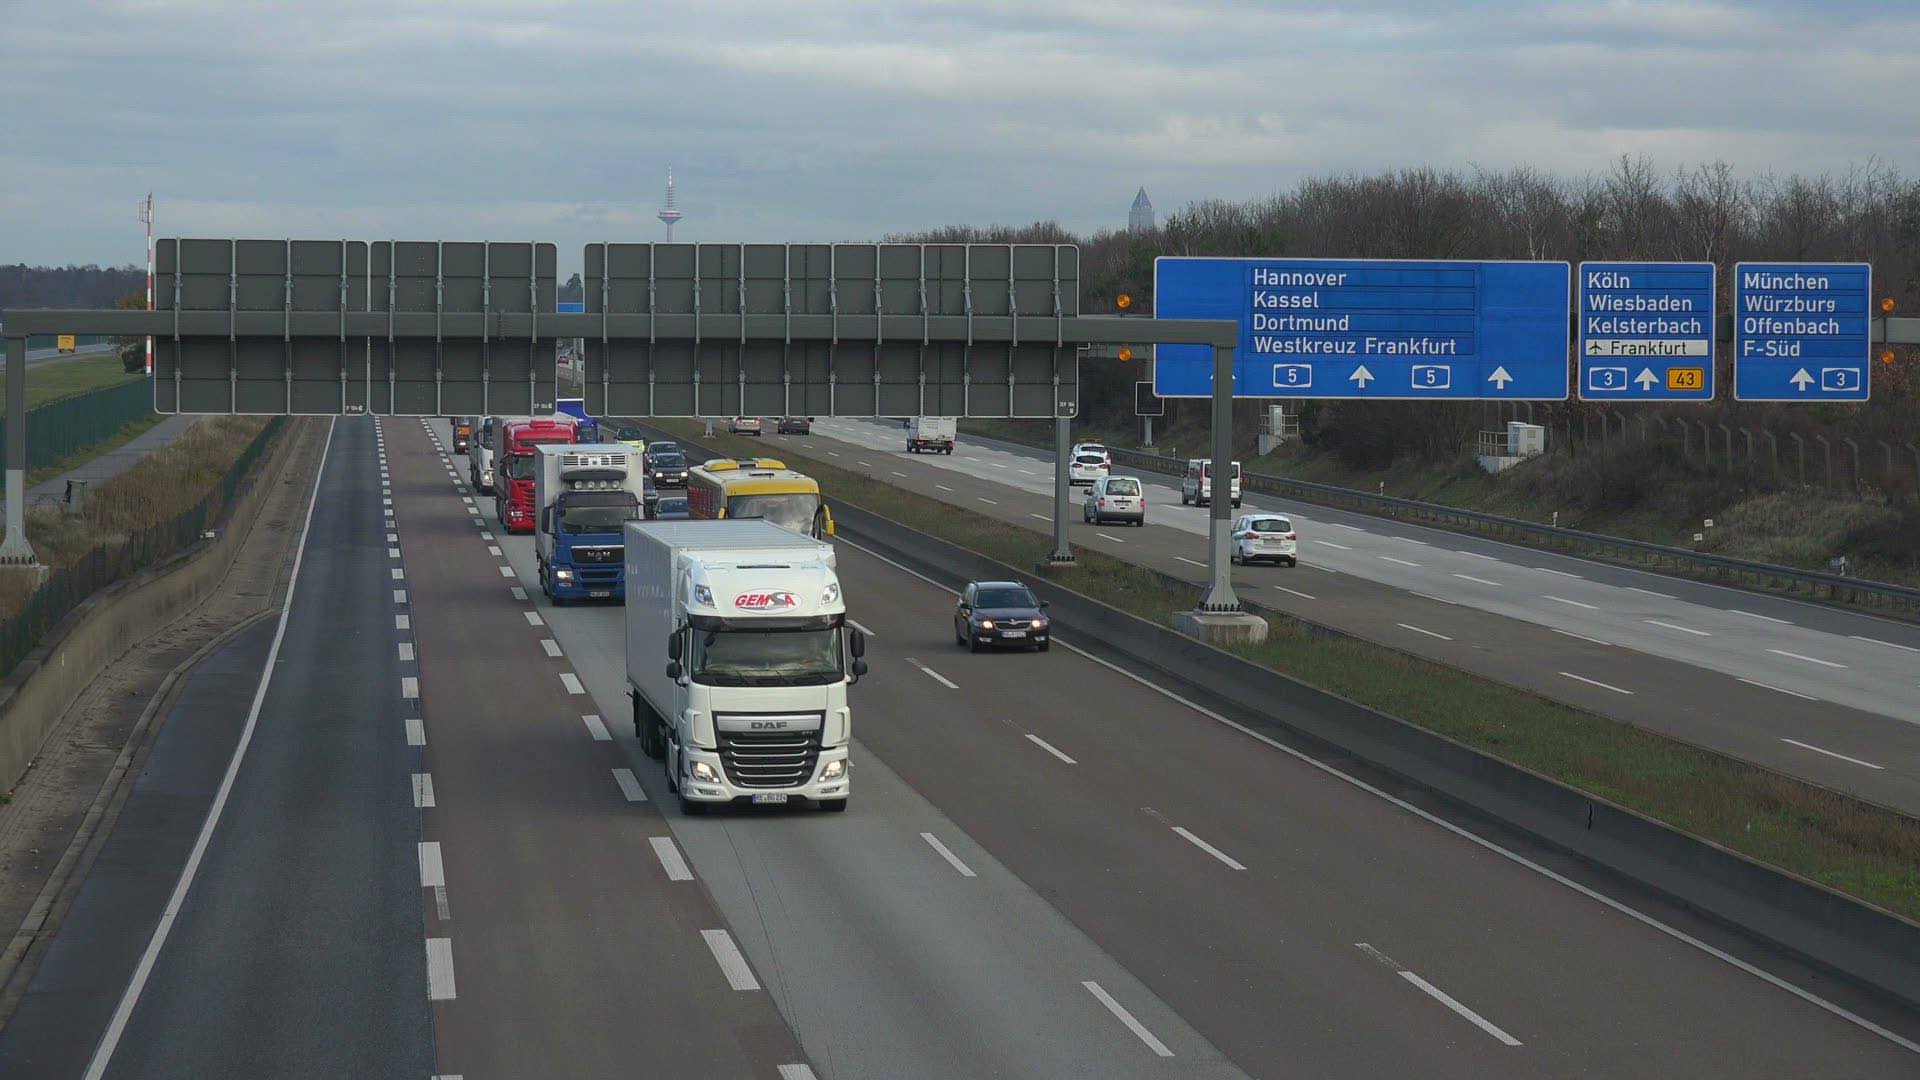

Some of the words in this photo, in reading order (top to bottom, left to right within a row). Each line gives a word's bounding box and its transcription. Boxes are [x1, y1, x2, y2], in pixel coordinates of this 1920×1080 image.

[1254, 268, 1346, 286] Hannover
[1588, 271, 1630, 289] Köln
[1744, 272, 1829, 290] München
[1254, 291, 1320, 309] Kassel
[1589, 294, 1692, 312] Wiesbaden
[1745, 295, 1835, 313] Würzburg
[1254, 314, 1349, 331] Dortmund
[1588, 317, 1701, 334] Kelsterbach
[1744, 317, 1839, 335] Offenbach
[1254, 336, 1357, 354] Westkreuz
[1365, 336, 1456, 355] Frankfurt
[1610, 341, 1687, 355] Frankfurt
[1744, 340, 1801, 357] F-Süd
[1288, 369, 1297, 384] 5
[1426, 370, 1436, 384] 5
[1604, 372, 1613, 386] 3
[1676, 372, 1695, 386] 43
[1837, 372, 1846, 386] 3
[735, 592, 797, 607] GEMSA
[750, 721, 788, 729] DAF
